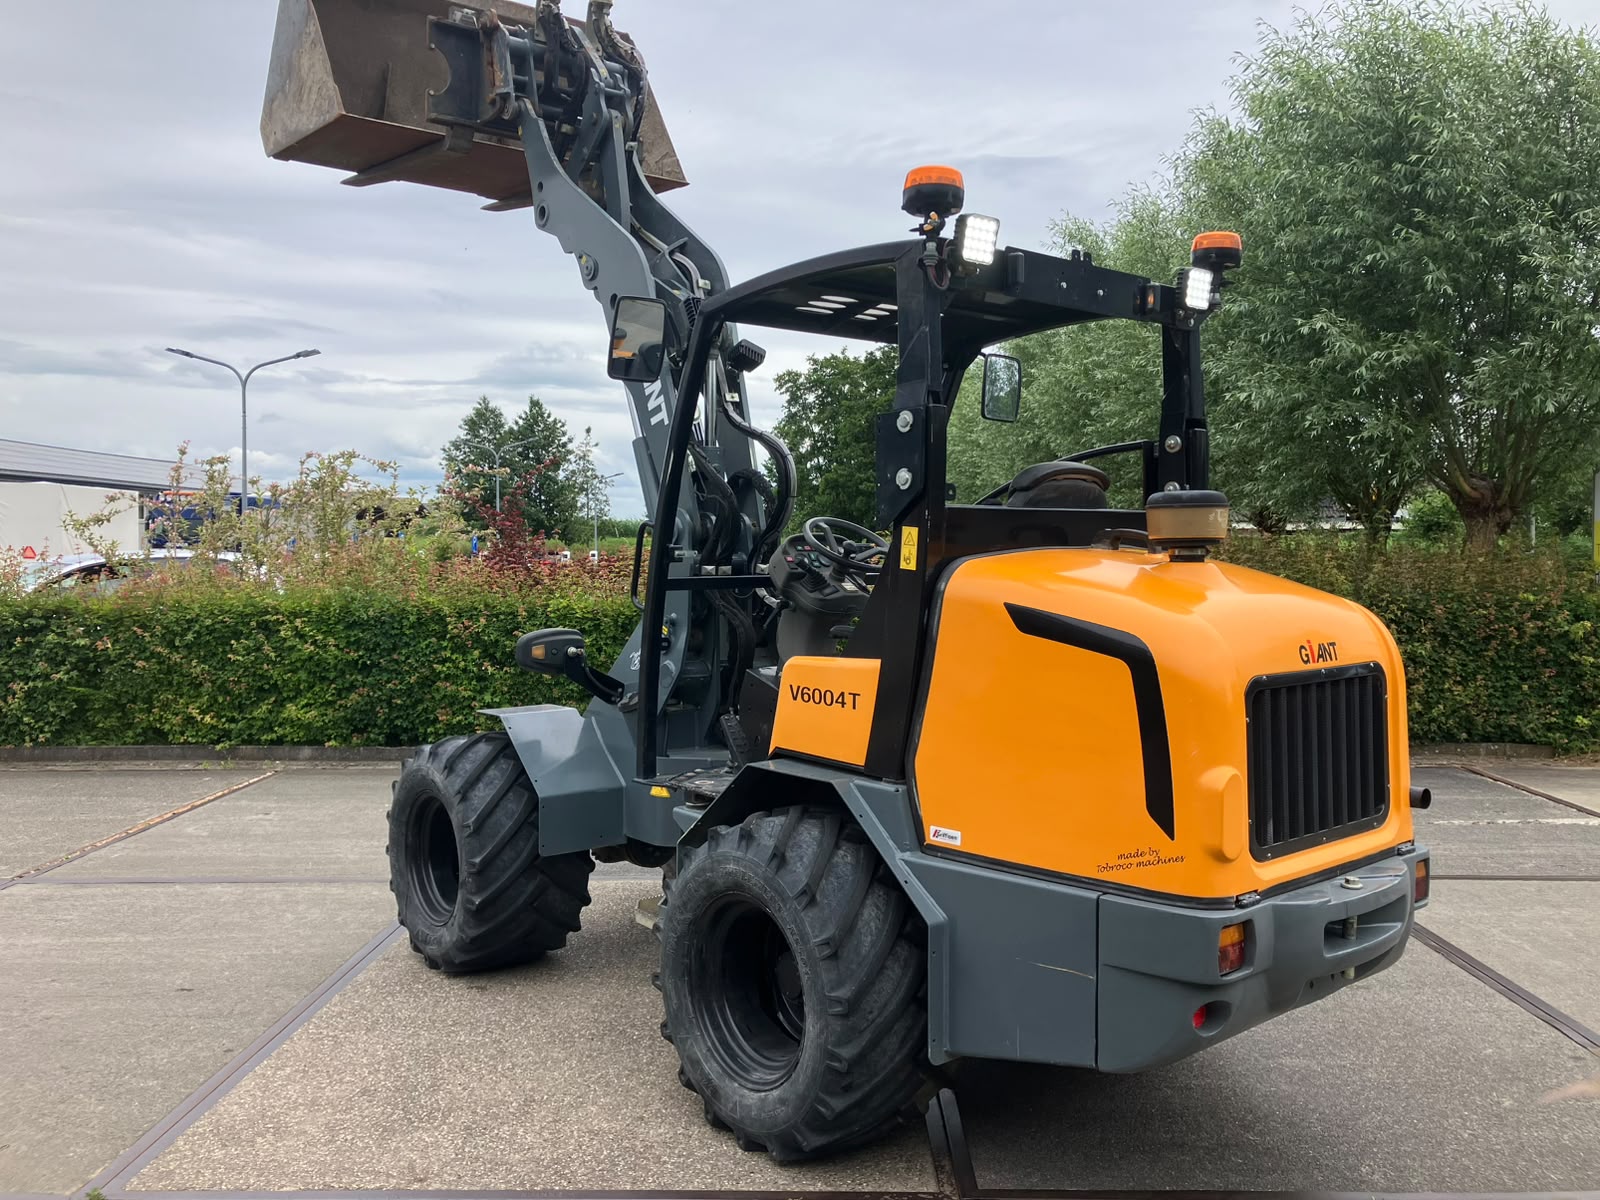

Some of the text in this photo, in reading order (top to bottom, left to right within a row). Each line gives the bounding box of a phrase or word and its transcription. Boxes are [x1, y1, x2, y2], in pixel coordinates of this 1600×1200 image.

[643, 379, 669, 426] NT
[789, 684, 861, 710] V6004T
[1097, 855, 1185, 873] Tobroco machines
[1117, 847, 1160, 860] made by
